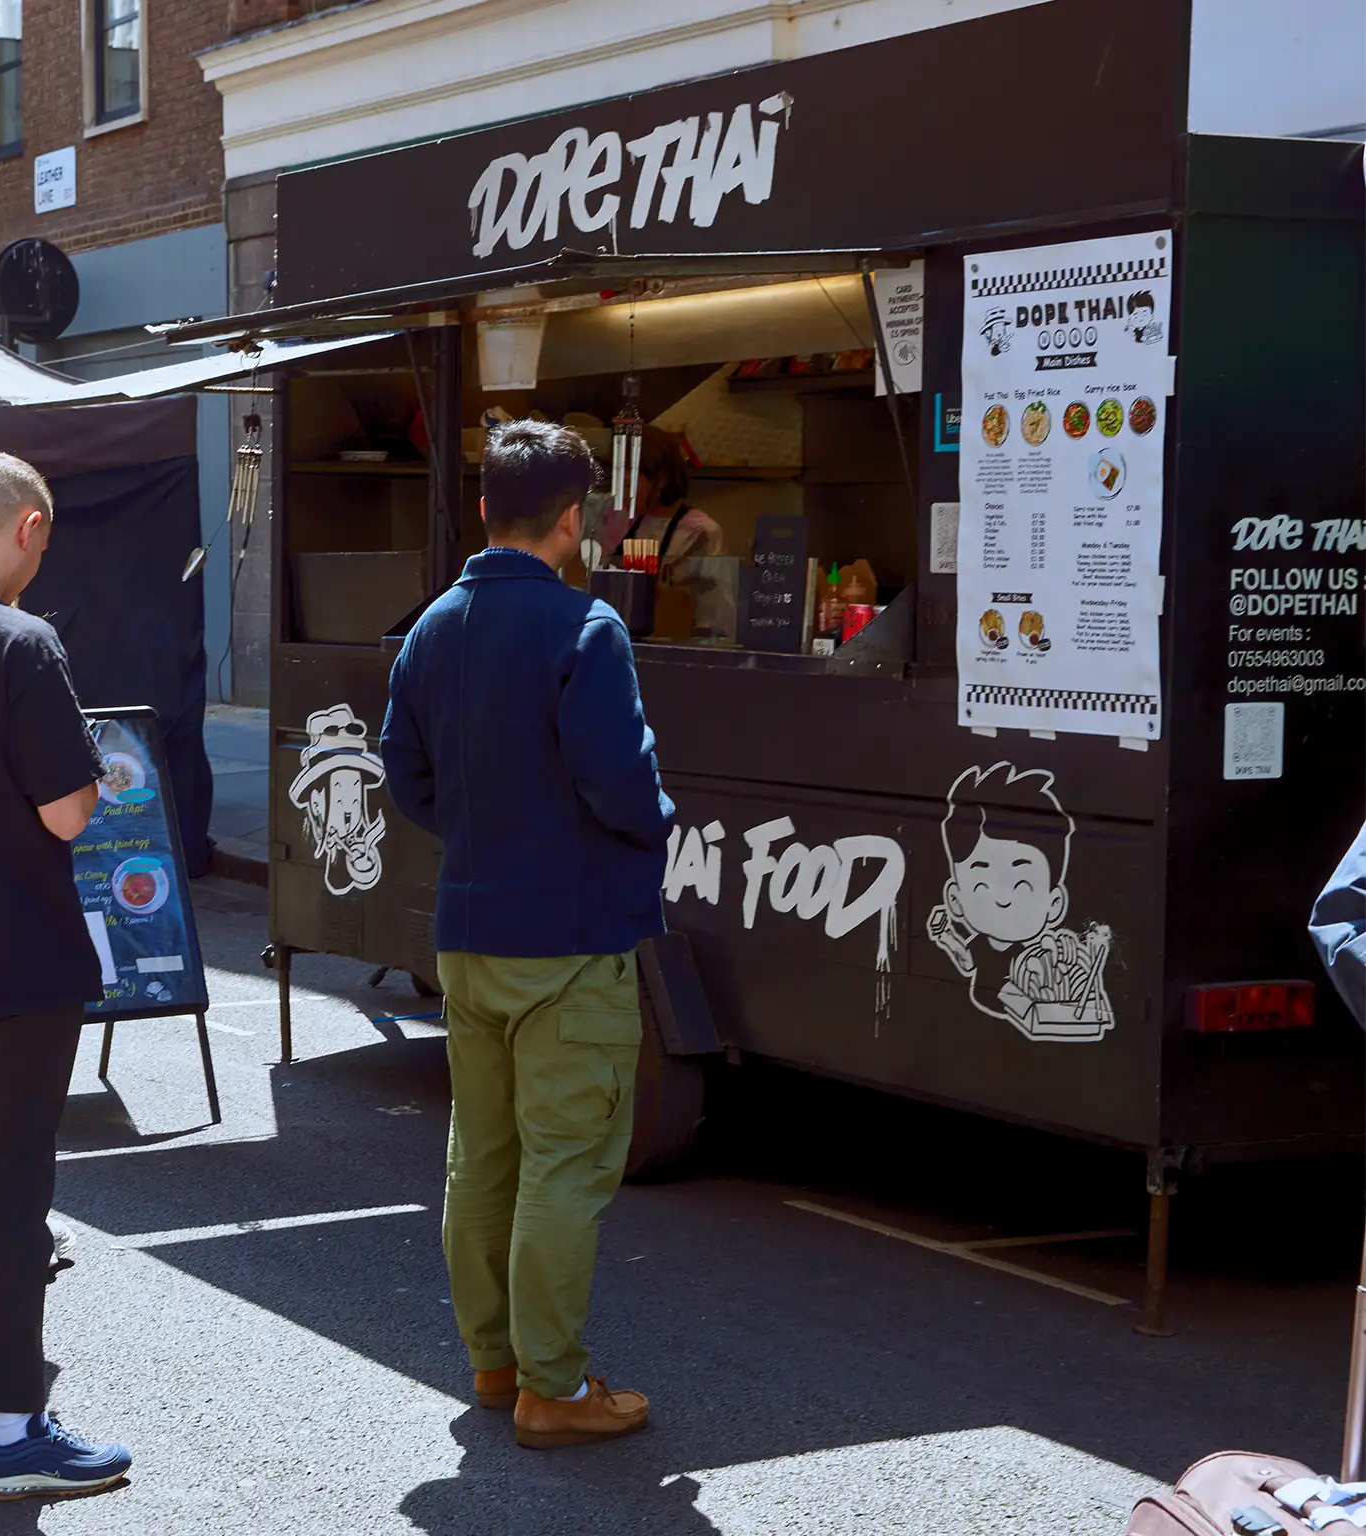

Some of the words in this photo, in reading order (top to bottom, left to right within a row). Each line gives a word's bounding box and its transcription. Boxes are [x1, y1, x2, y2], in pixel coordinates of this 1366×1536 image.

[1015, 301, 1070, 328] DOPE
[1074, 295, 1124, 322] THAI
[1042, 356, 1063, 368] Main
[1230, 568, 1323, 590] FOLLOW
[1328, 568, 1359, 590] US
[1229, 594, 1358, 616] @DOPETHAI
[1228, 624, 1254, 642] For
[1255, 625, 1303, 642] events
[1227, 649, 1325, 668] 07554963003
[1227, 674, 1366, 697] dopethai@gmail.co
[103, 804, 122, 816] Pad
